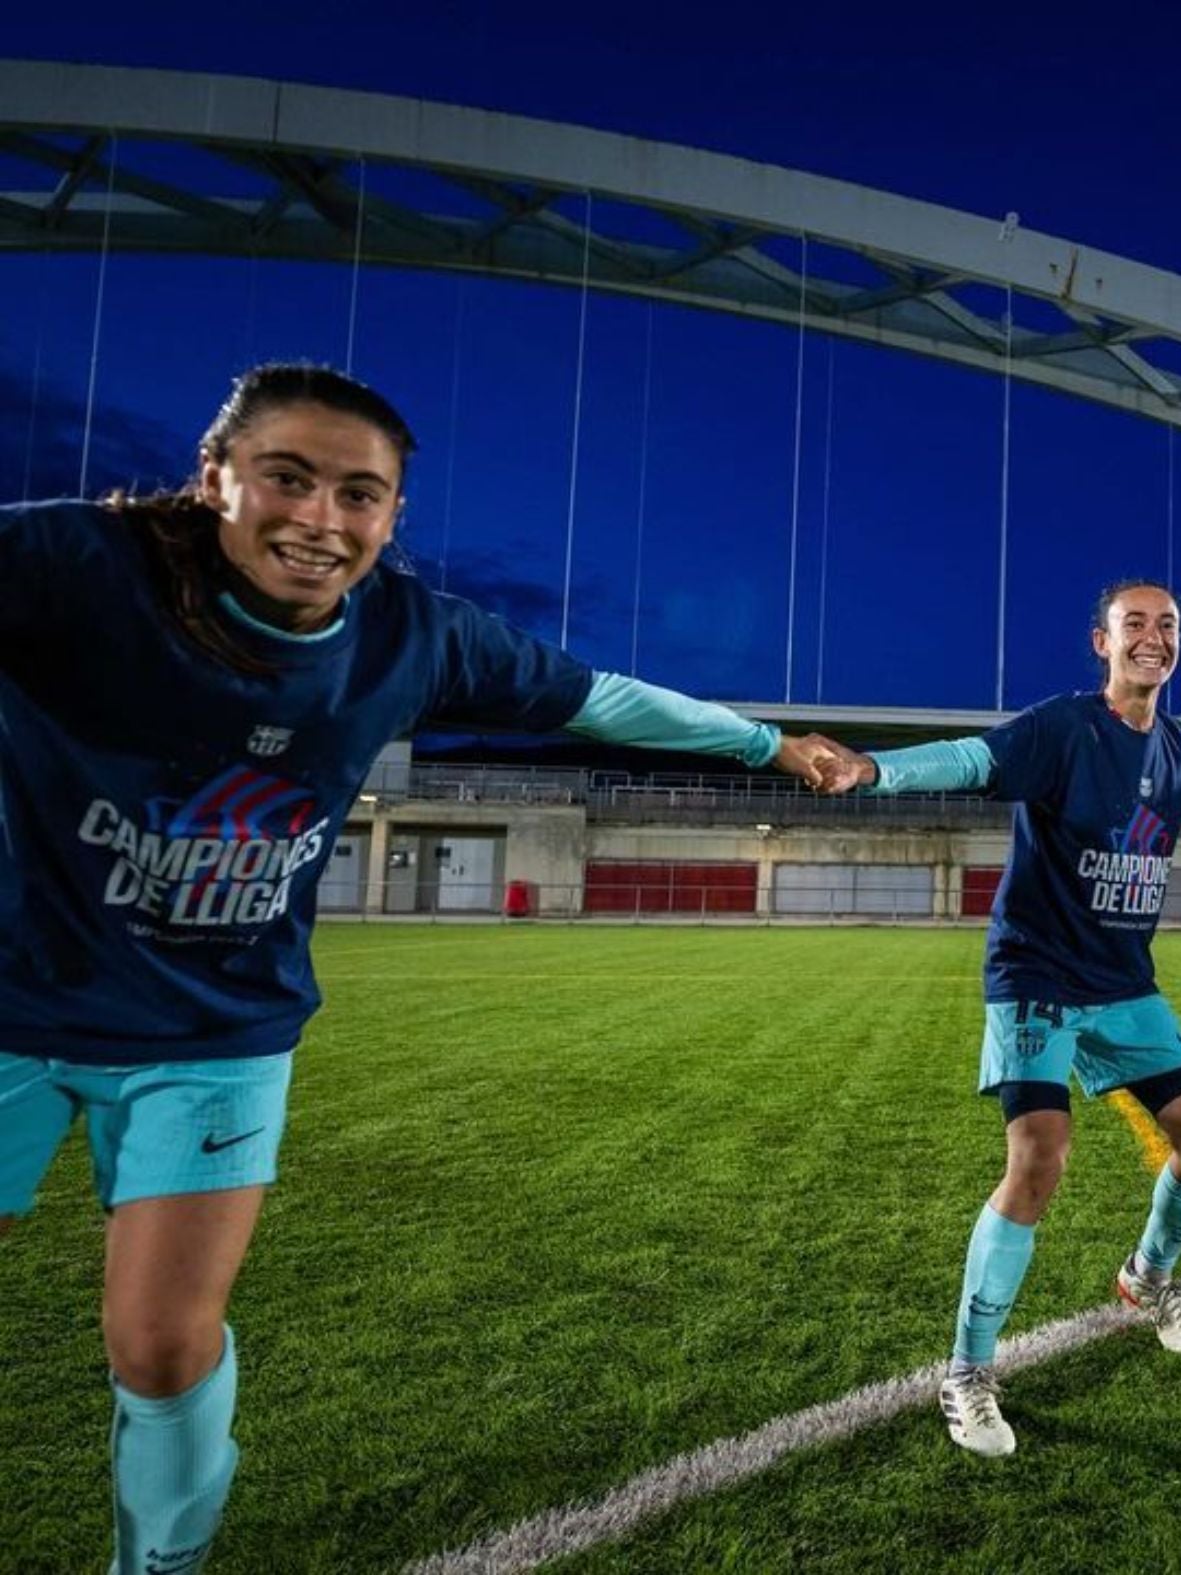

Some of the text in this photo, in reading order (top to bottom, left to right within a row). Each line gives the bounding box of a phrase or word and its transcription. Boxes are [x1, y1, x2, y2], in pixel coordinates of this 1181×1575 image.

[78, 798, 329, 880] CAMPIONES
[104, 856, 292, 925] DE LLIGA
[1091, 880, 1123, 913] DE
[1014, 999, 1064, 1030] 14
